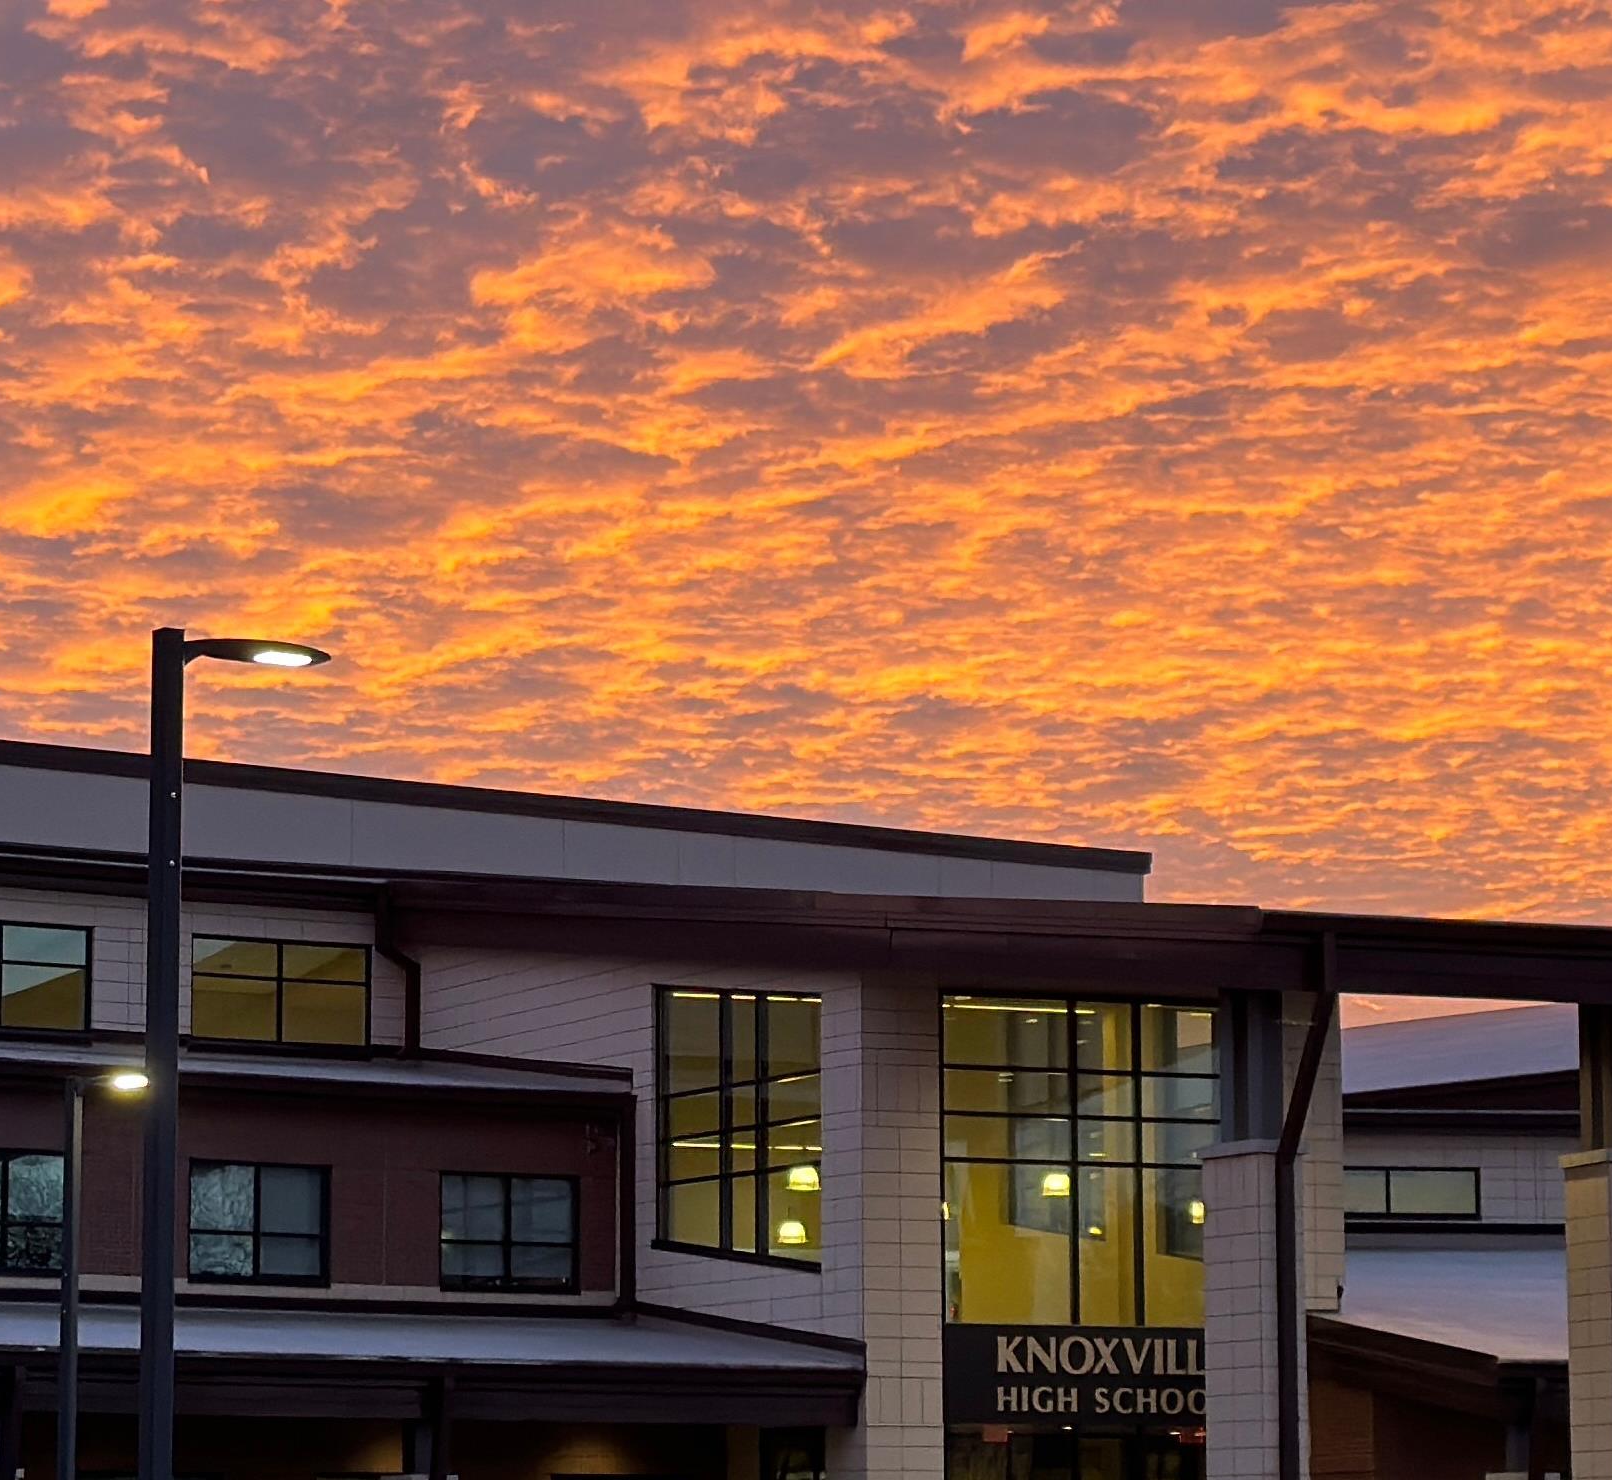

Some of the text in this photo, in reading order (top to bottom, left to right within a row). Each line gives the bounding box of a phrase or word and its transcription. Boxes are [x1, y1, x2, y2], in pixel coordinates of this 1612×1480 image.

[996, 1335, 1205, 1375] KNOXVILL
[996, 1386, 1205, 1414] HIGH SCHOO
